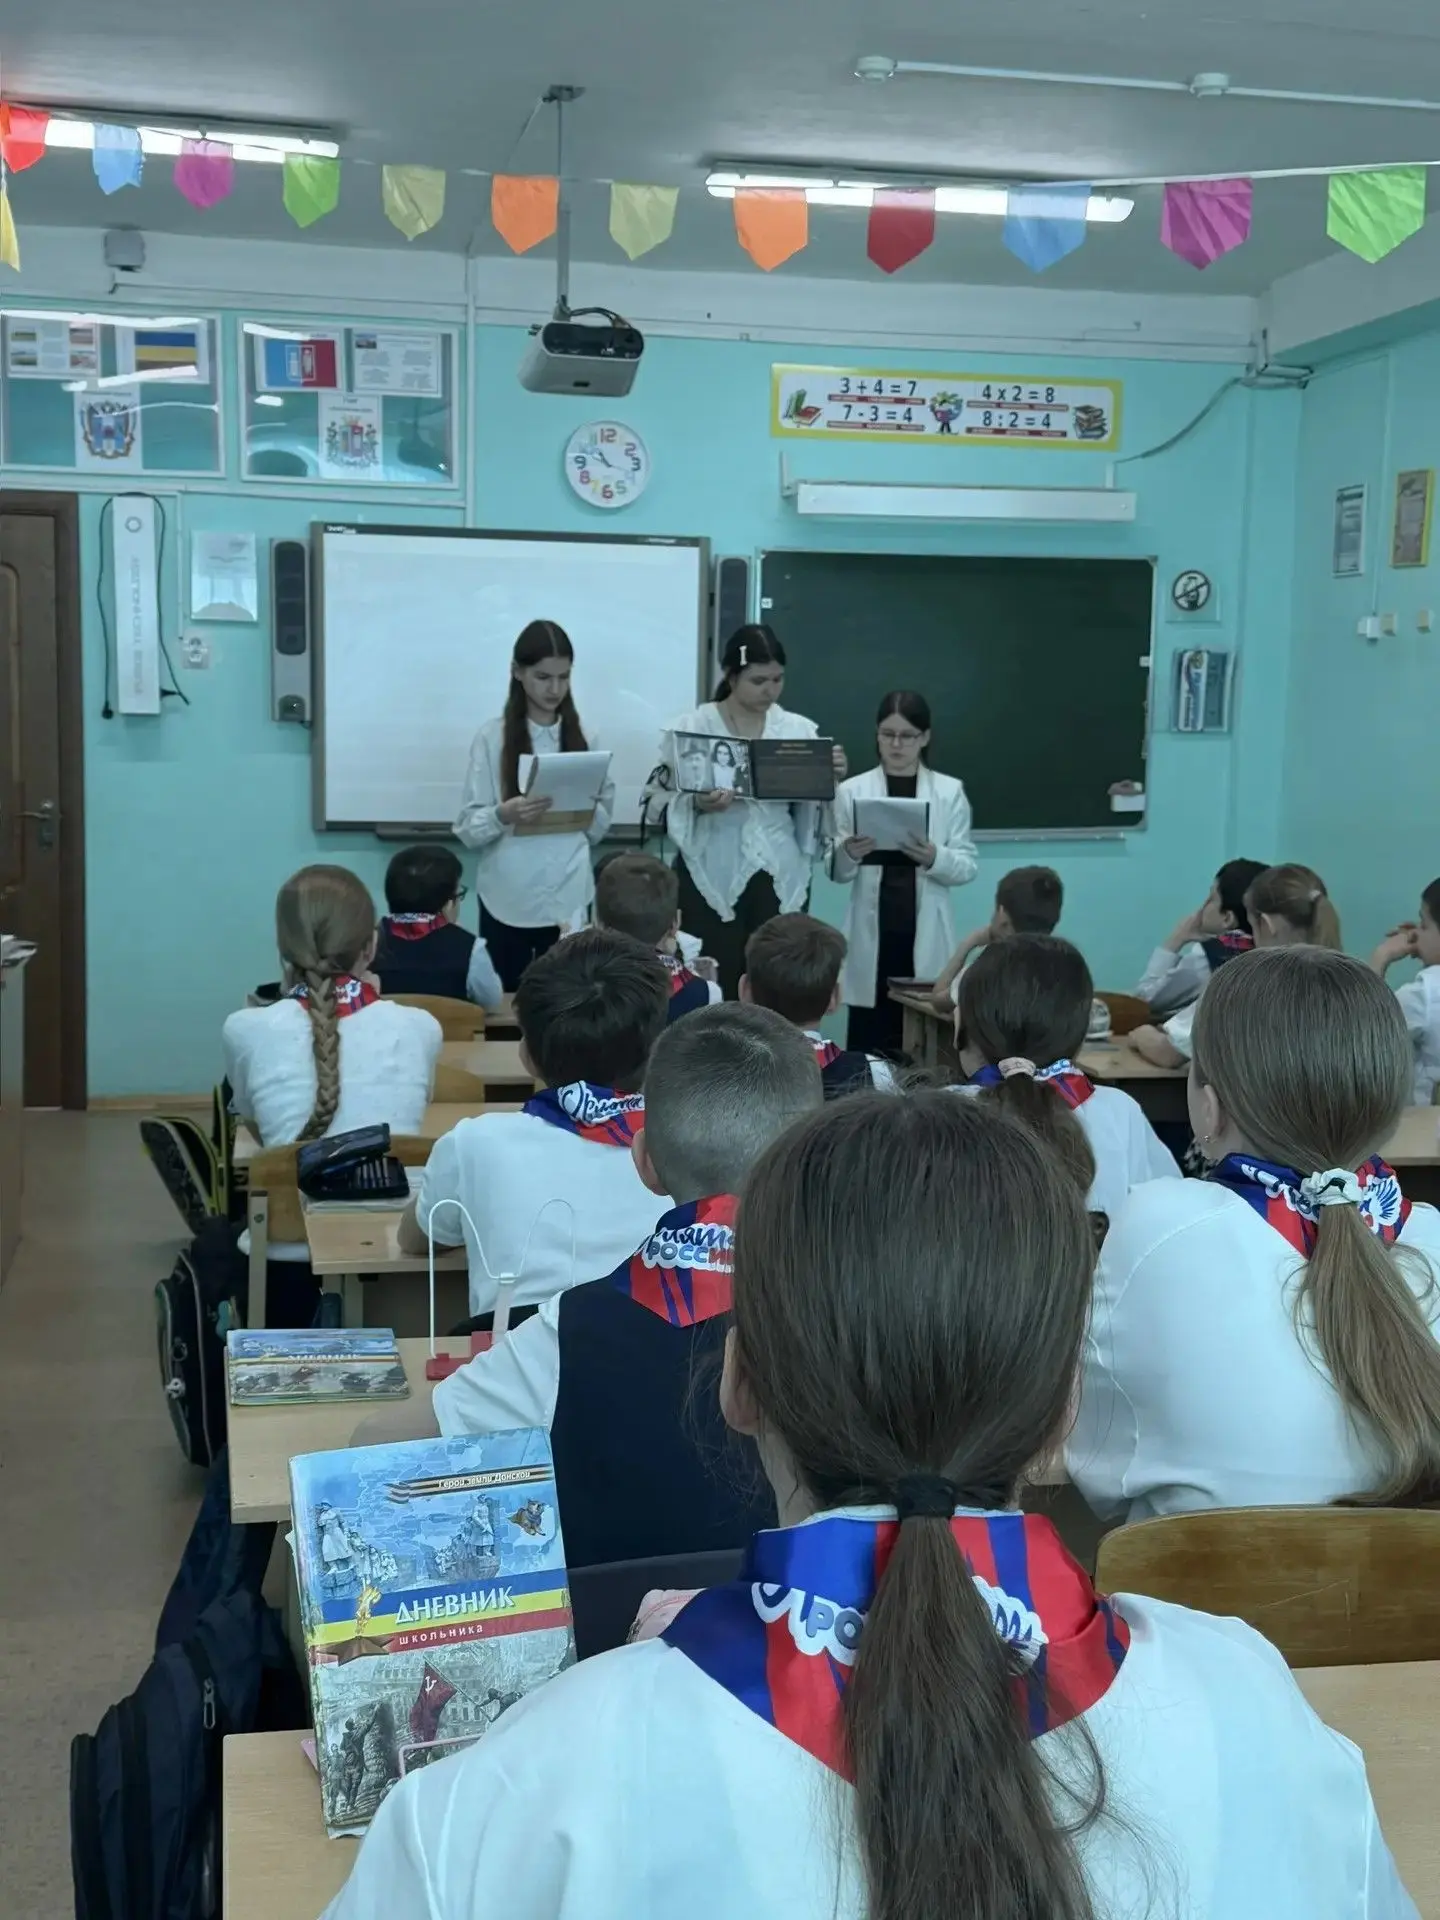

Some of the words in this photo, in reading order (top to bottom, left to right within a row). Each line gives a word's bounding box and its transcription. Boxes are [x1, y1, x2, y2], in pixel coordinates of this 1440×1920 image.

[840, 377, 850, 394] 3
[874, 379, 883, 395] 4
[907, 380, 917, 396] 7
[982, 384, 992, 400] 4
[1012, 385, 1022, 401] 2
[1045, 387, 1055, 403] 8
[843, 404, 852, 420] 7
[869, 405, 879, 421] 3
[903, 407, 913, 422] 4
[983, 410, 992, 426] 8
[1009, 412, 1019, 428] 2
[1042, 413, 1051, 429] 4
[600, 428, 617, 443] 12
[624, 442, 637, 457] 2
[574, 455, 587, 470] 9
[631, 456, 641, 472] 3
[580, 470, 591, 485] 8
[602, 484, 614, 499] 6
[615, 480, 627, 495] 5
[438, 1477, 465, 1489] Герои
[395, 1585, 515, 1625] ДНЕВНИК
[399, 1623, 484, 1645] школьника
